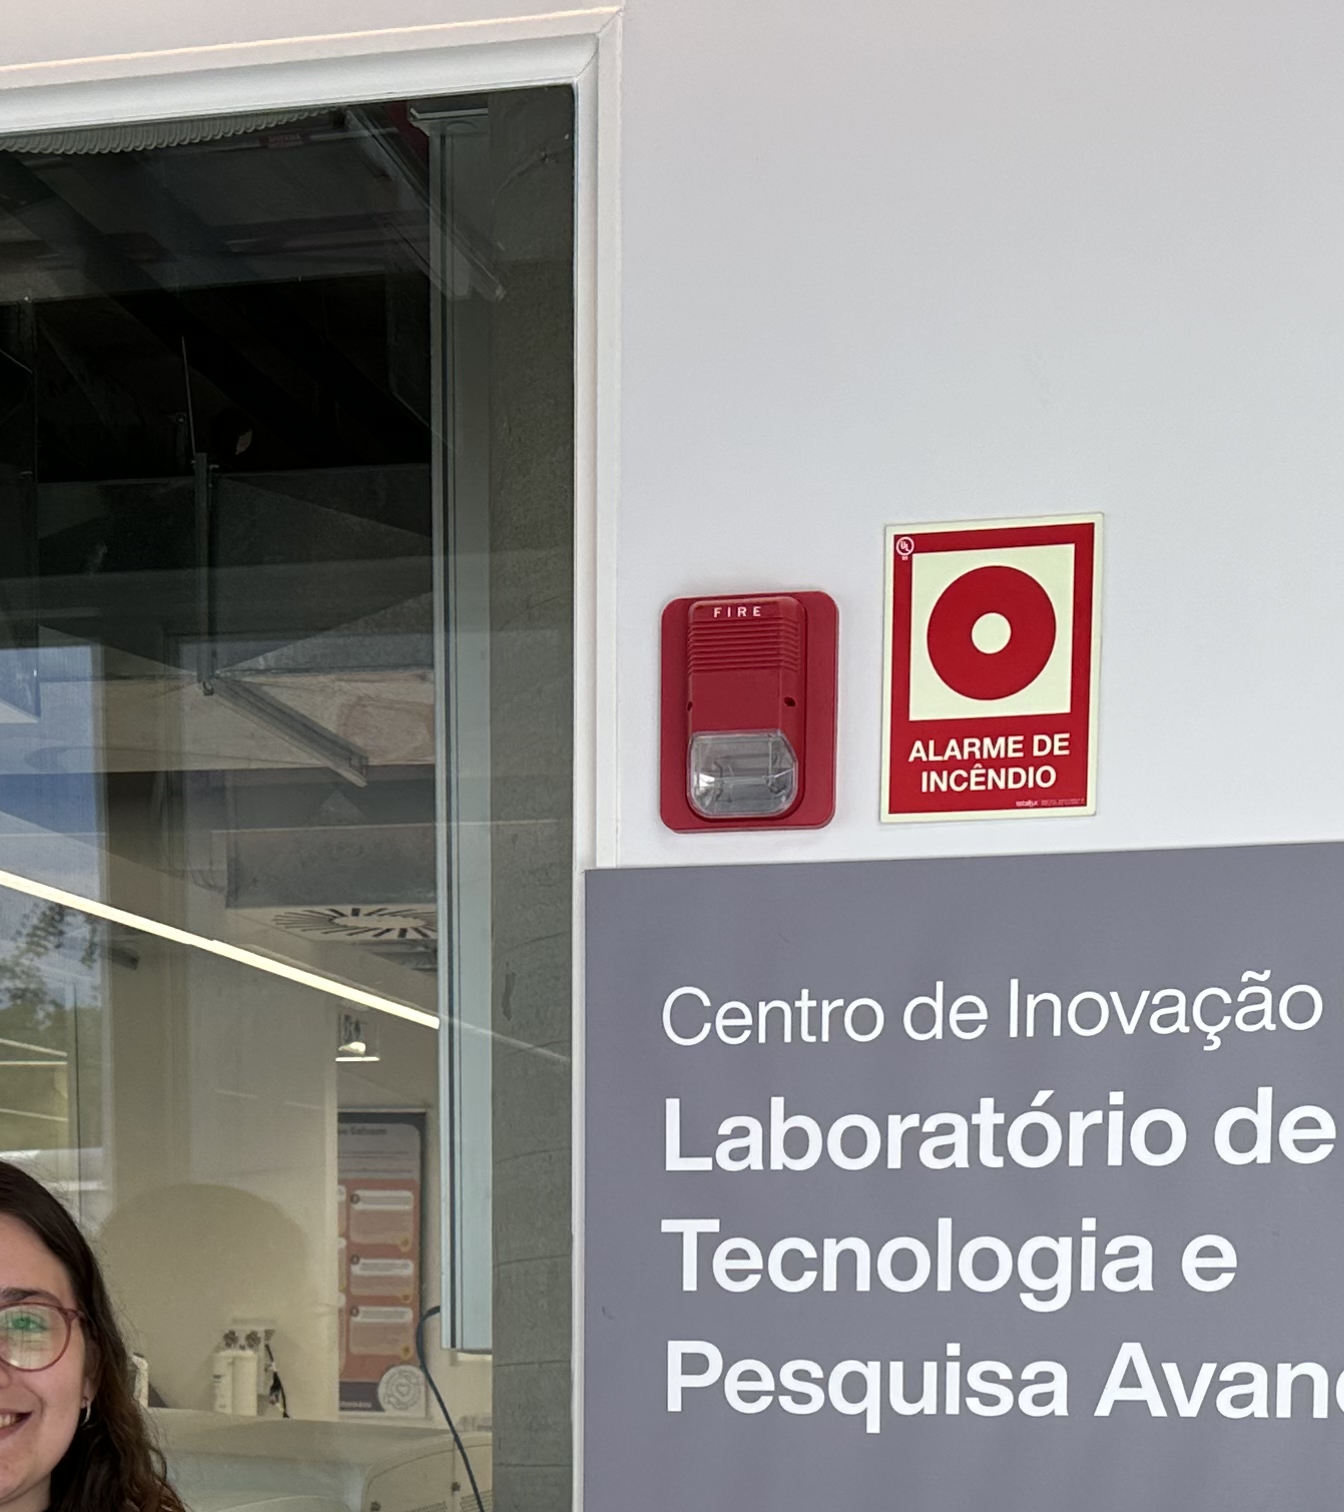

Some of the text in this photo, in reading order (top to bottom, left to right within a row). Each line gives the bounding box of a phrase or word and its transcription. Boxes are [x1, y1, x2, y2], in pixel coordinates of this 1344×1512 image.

[713, 605, 764, 618] FIRE
[908, 733, 1070, 763] ALARME DE
[921, 763, 1057, 793] INCÊNDIO
[662, 986, 885, 1046] Centro
[903, 980, 989, 1041] de
[1009, 969, 1323, 1051] Inovação
[665, 1086, 1337, 1172] Laboratório de
[660, 1217, 1238, 1313] Tecnologia e
[667, 1340, 1069, 1434] Pesquisa
